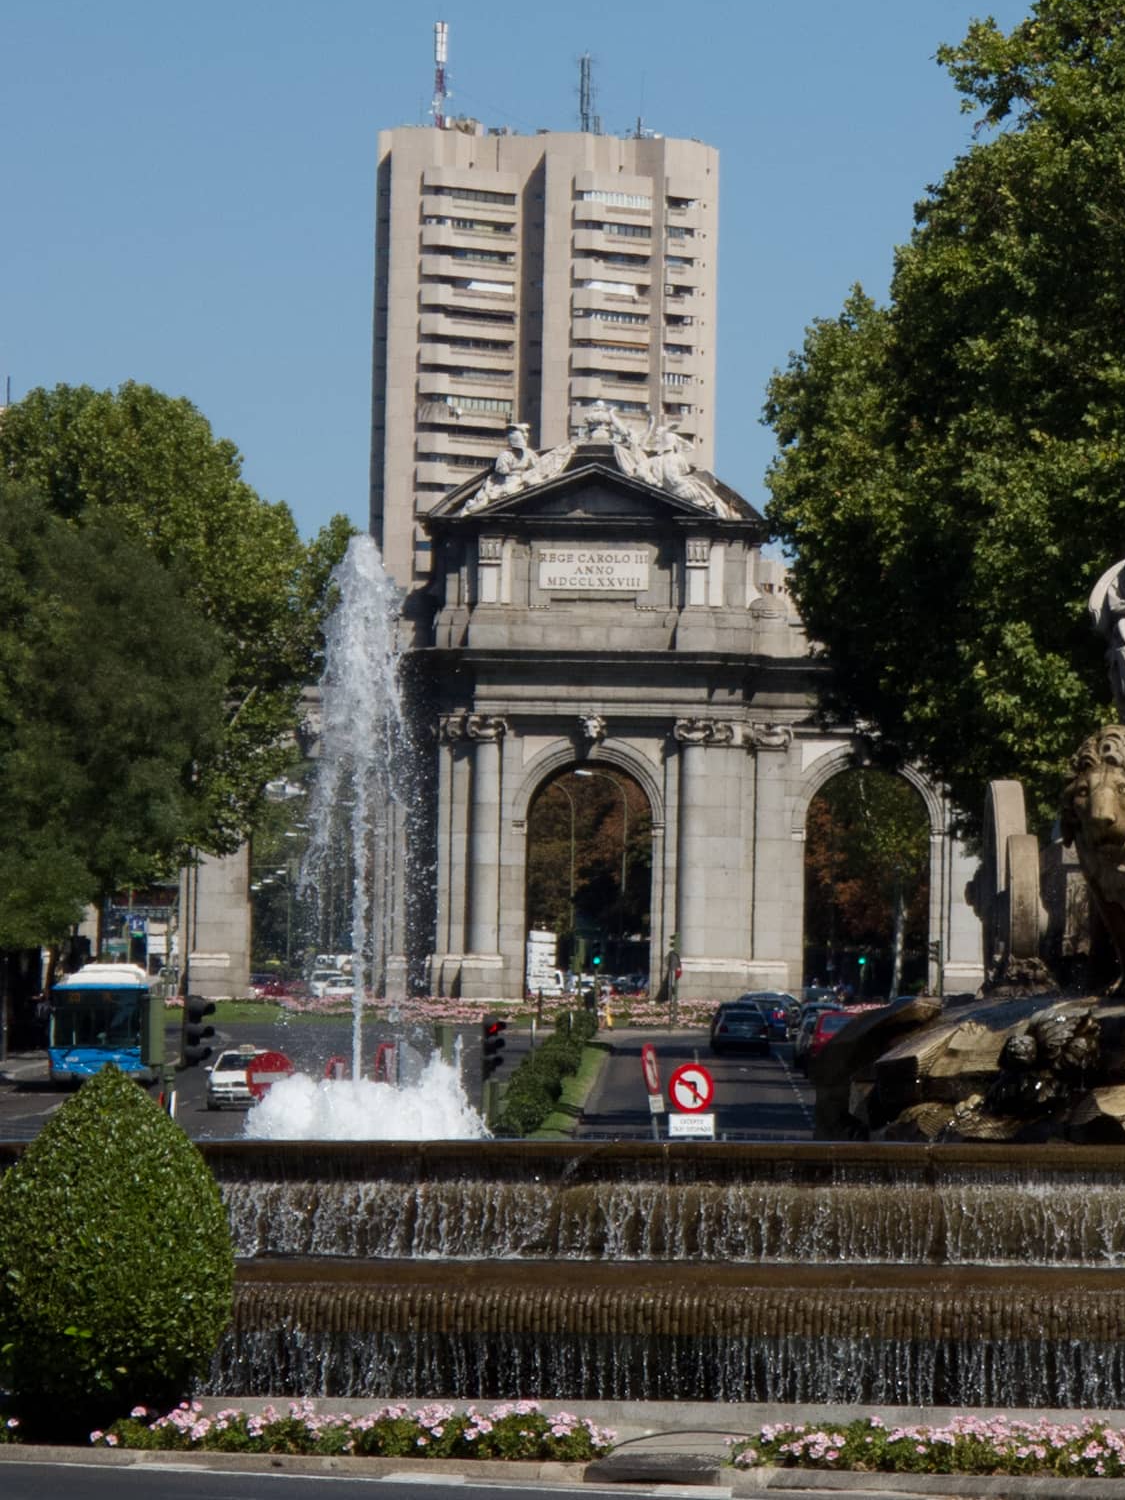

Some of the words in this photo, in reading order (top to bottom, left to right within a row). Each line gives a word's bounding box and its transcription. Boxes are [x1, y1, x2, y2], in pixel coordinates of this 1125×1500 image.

[539, 553, 574, 563] REGE
[577, 553, 630, 564] CAROLO
[634, 554, 649, 565] III
[574, 565, 614, 575] ANNO
[547, 576, 641, 587] MDCCLXXVIII
